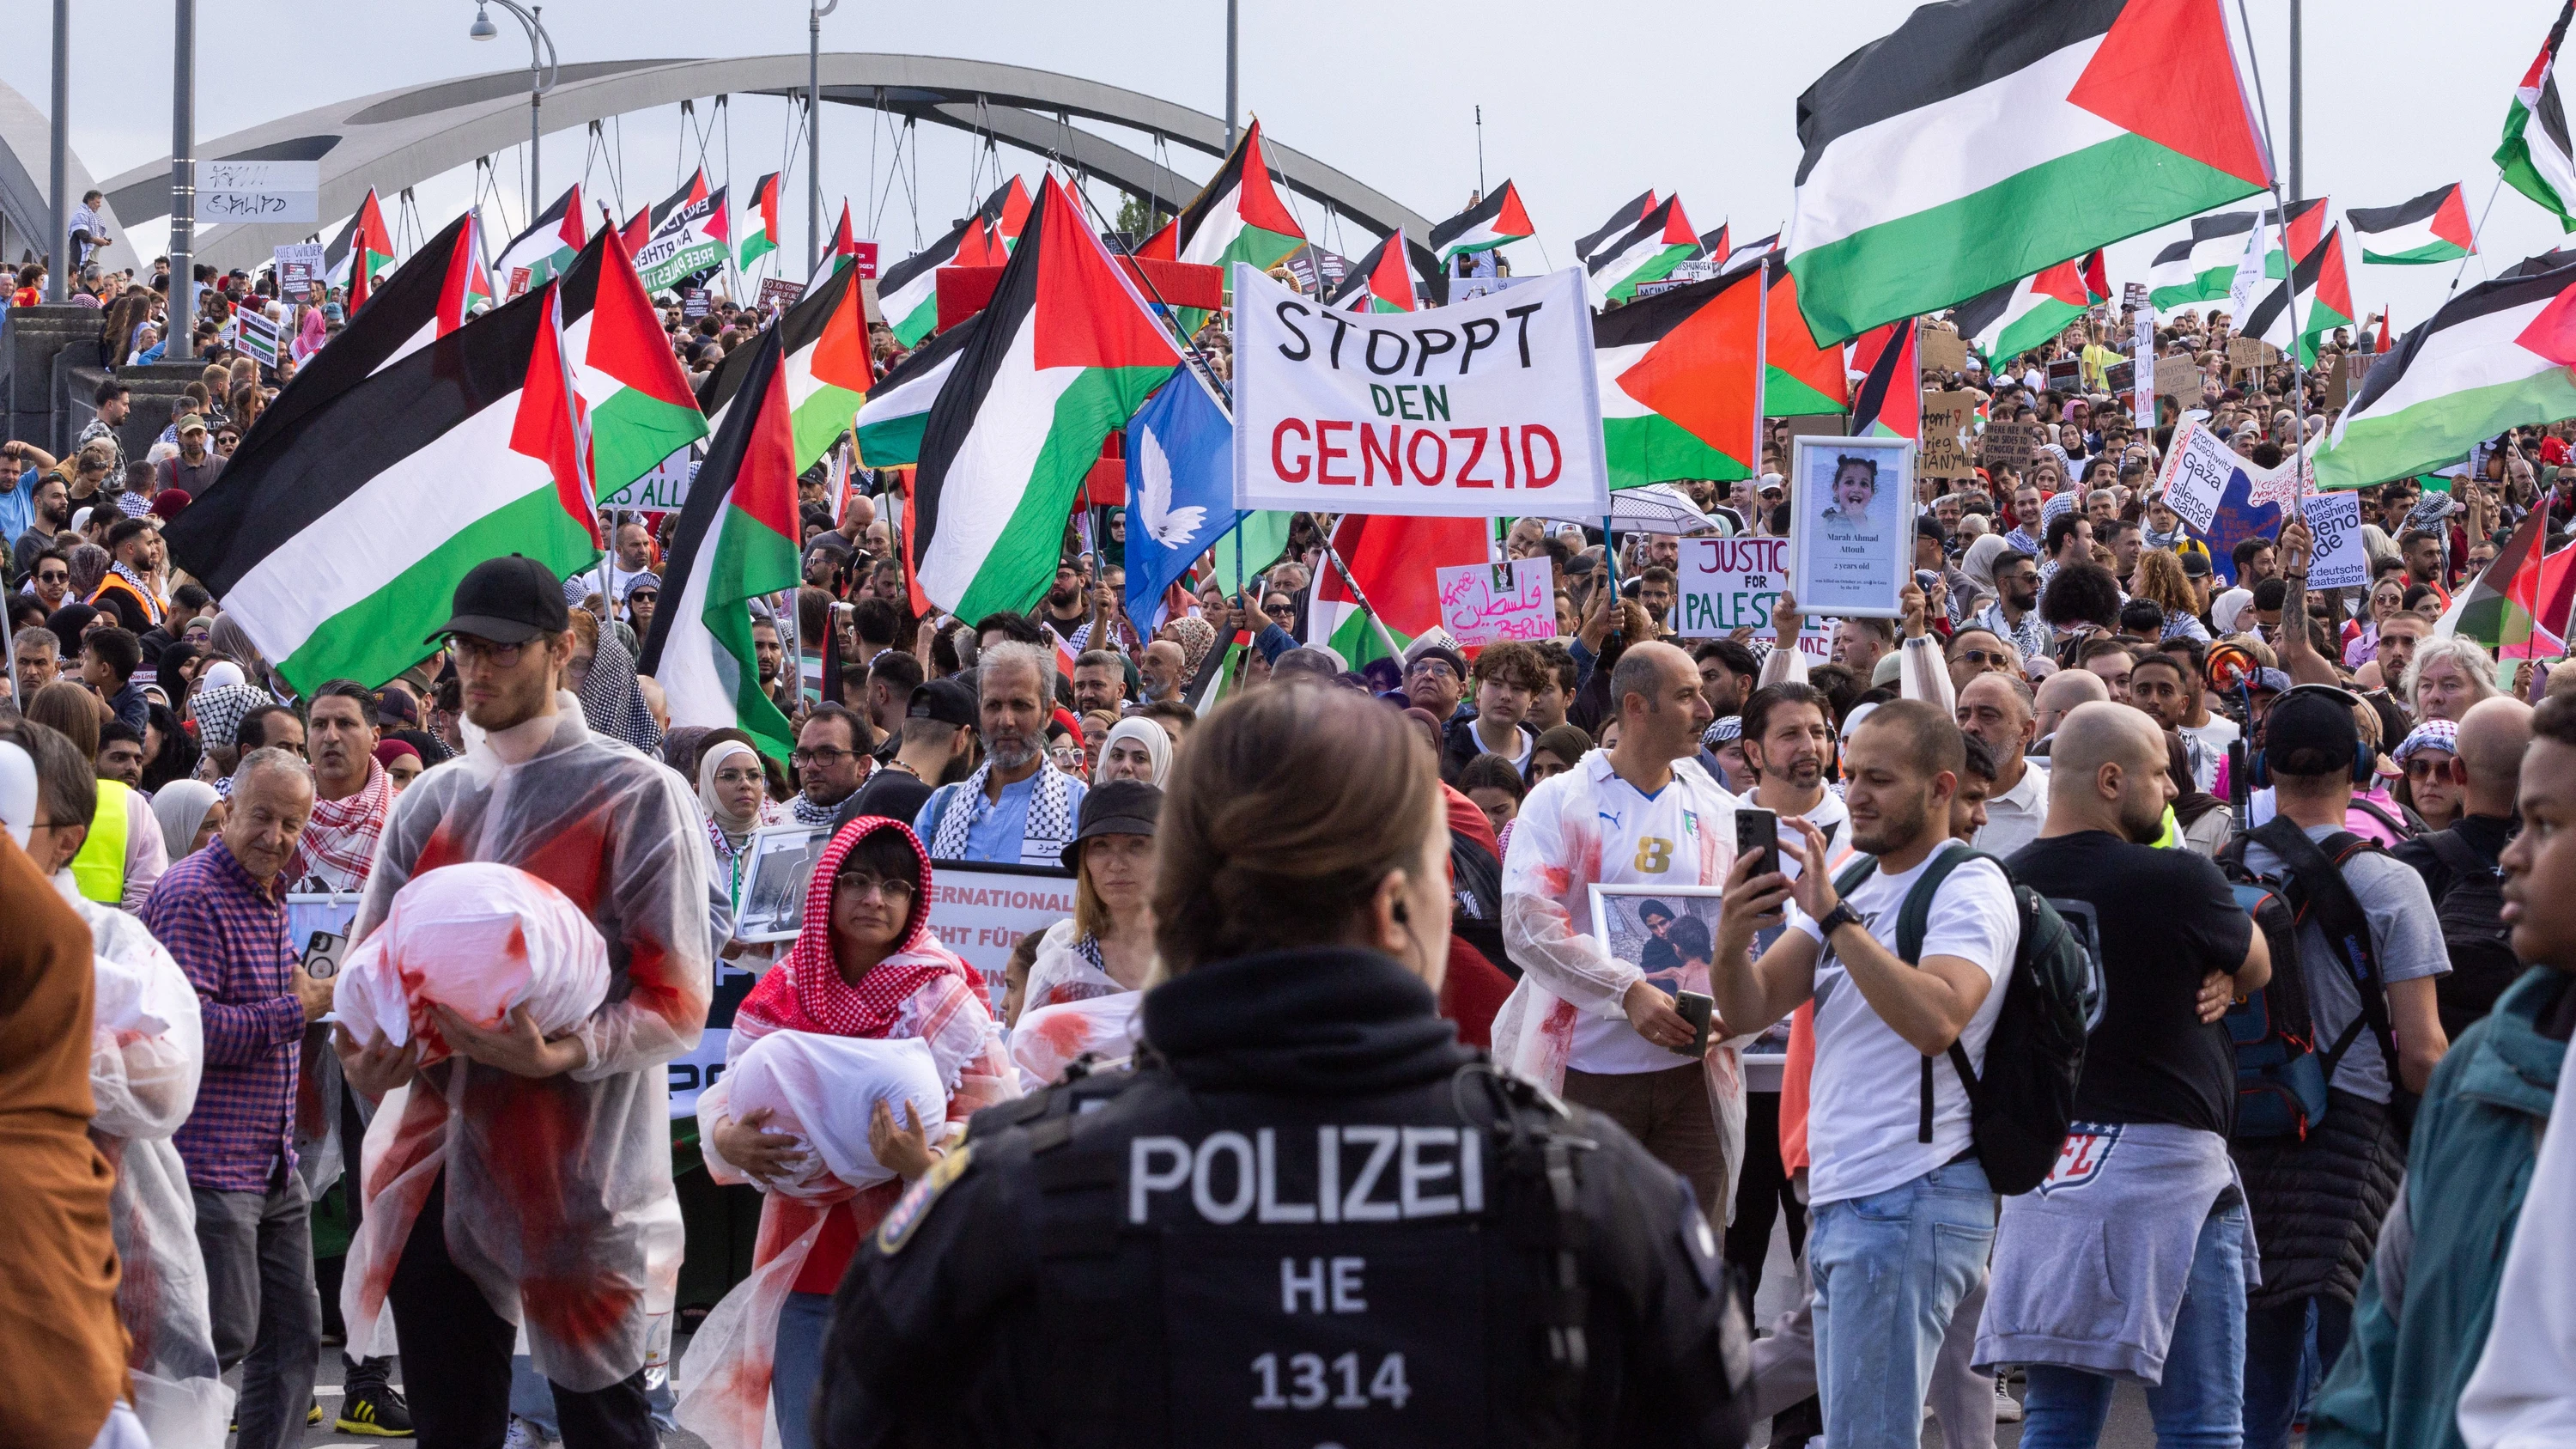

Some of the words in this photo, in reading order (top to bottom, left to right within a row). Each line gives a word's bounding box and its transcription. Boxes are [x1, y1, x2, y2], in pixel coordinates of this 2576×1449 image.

[276, 247, 290, 258] NIE
[294, 246, 323, 257] WIEDER
[763, 279, 773, 289] DO
[240, 310, 249, 319] STOP
[258, 319, 276, 332] OCCUPATION
[239, 340, 250, 352] FREE
[251, 345, 275, 364] PALESTINE
[1276, 301, 1542, 376] STOPPT
[1369, 383, 1450, 421] DEN
[1922, 405, 1951, 429] toppt
[1923, 436, 1951, 453] rieg
[1986, 425, 2006, 435] THERE
[2008, 426, 2019, 435] ARE
[2023, 426, 2033, 435] NO
[2002, 435, 2018, 444] SIDES
[2193, 428, 2215, 449] From
[1271, 417, 1562, 489] GENOZID
[2190, 438, 2233, 473] Auschwitz
[2207, 460, 2215, 472] to
[2184, 452, 2221, 491] Gaza
[640, 478, 683, 507] ALL
[2172, 483, 2212, 520] silence
[2172, 497, 2206, 531] same.
[2306, 501, 2357, 524] washing
[2308, 514, 2358, 544] geno
[1699, 539, 1787, 573] JUSTIC
[2317, 564, 2363, 576] deutsche
[1440, 571, 1476, 606] Free
[1745, 575, 1767, 588] FOR
[1451, 571, 1541, 630] فلسطين
[1686, 593, 1820, 630] PALEST
[1634, 837, 1674, 874] 8
[932, 885, 1073, 913] ERNATIONAL
[928, 924, 971, 945] CHT
[2047, 1134, 2098, 1182] FL
[1128, 1125, 1484, 1225] POLIZEI
[1280, 1257, 1367, 1315] HE
[1250, 1352, 1412, 1410] 1314
